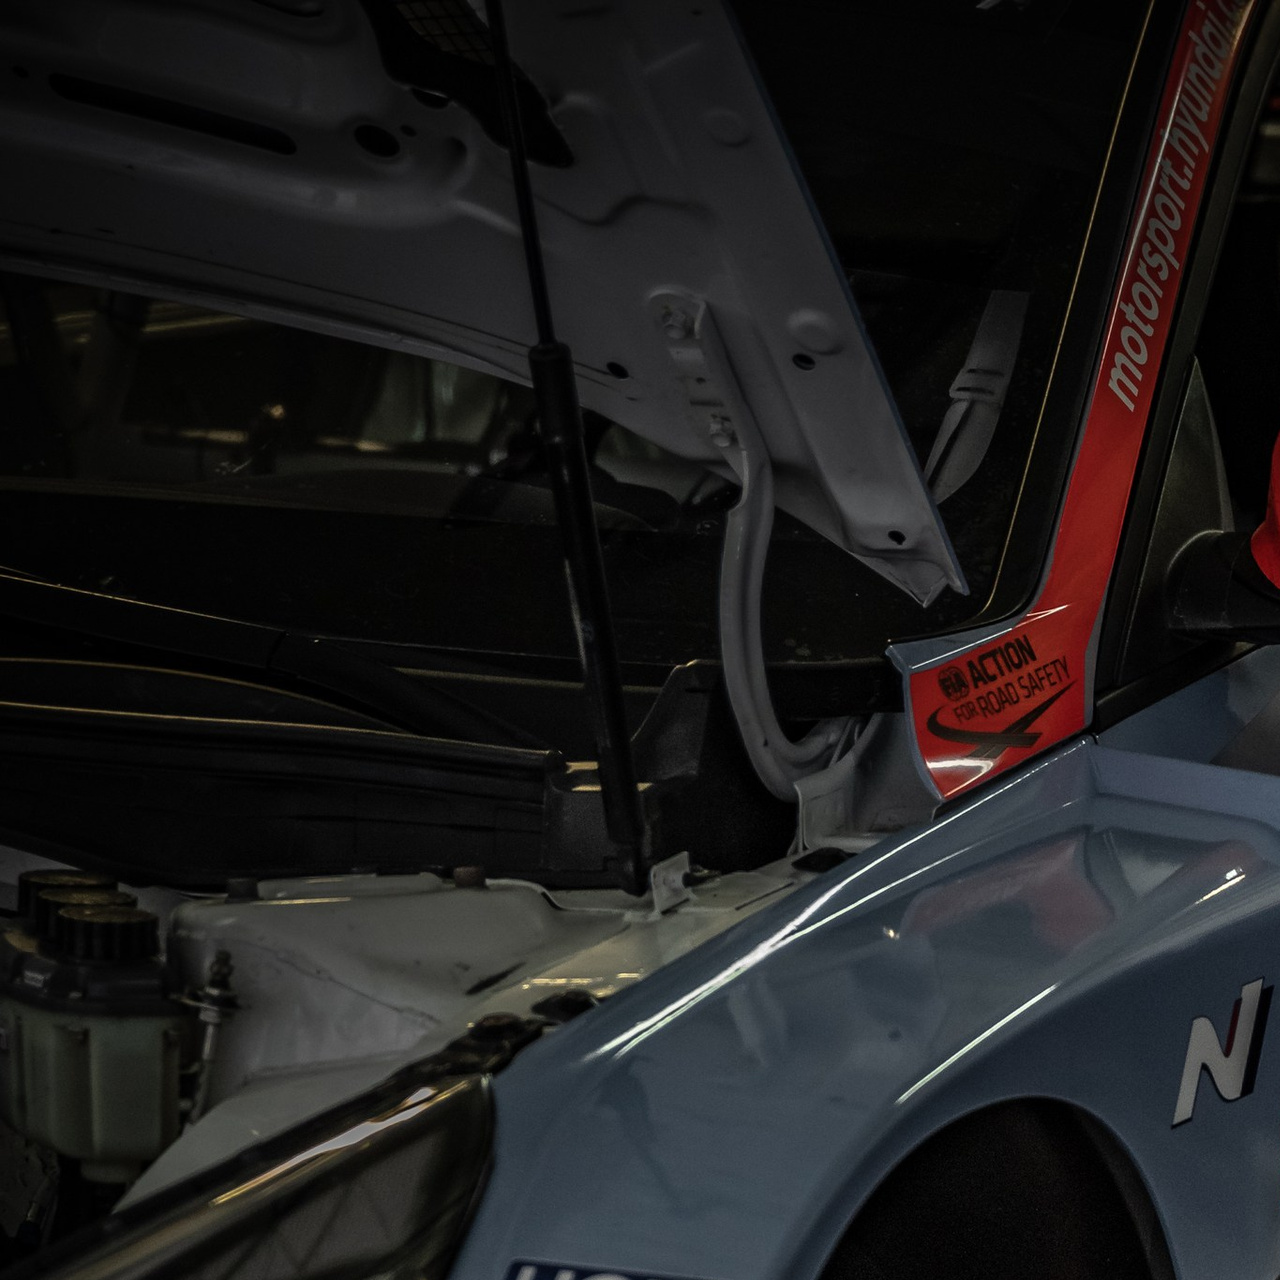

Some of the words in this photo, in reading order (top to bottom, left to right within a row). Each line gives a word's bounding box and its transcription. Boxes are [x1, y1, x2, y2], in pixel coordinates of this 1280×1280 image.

[1107, 0, 1245, 413] motorsport.hyundai.c
[953, 701, 978, 724] FOR
[975, 682, 1020, 719] ROAD
[1017, 655, 1071, 700] SAFETY
[967, 634, 1037, 689] ACTION
